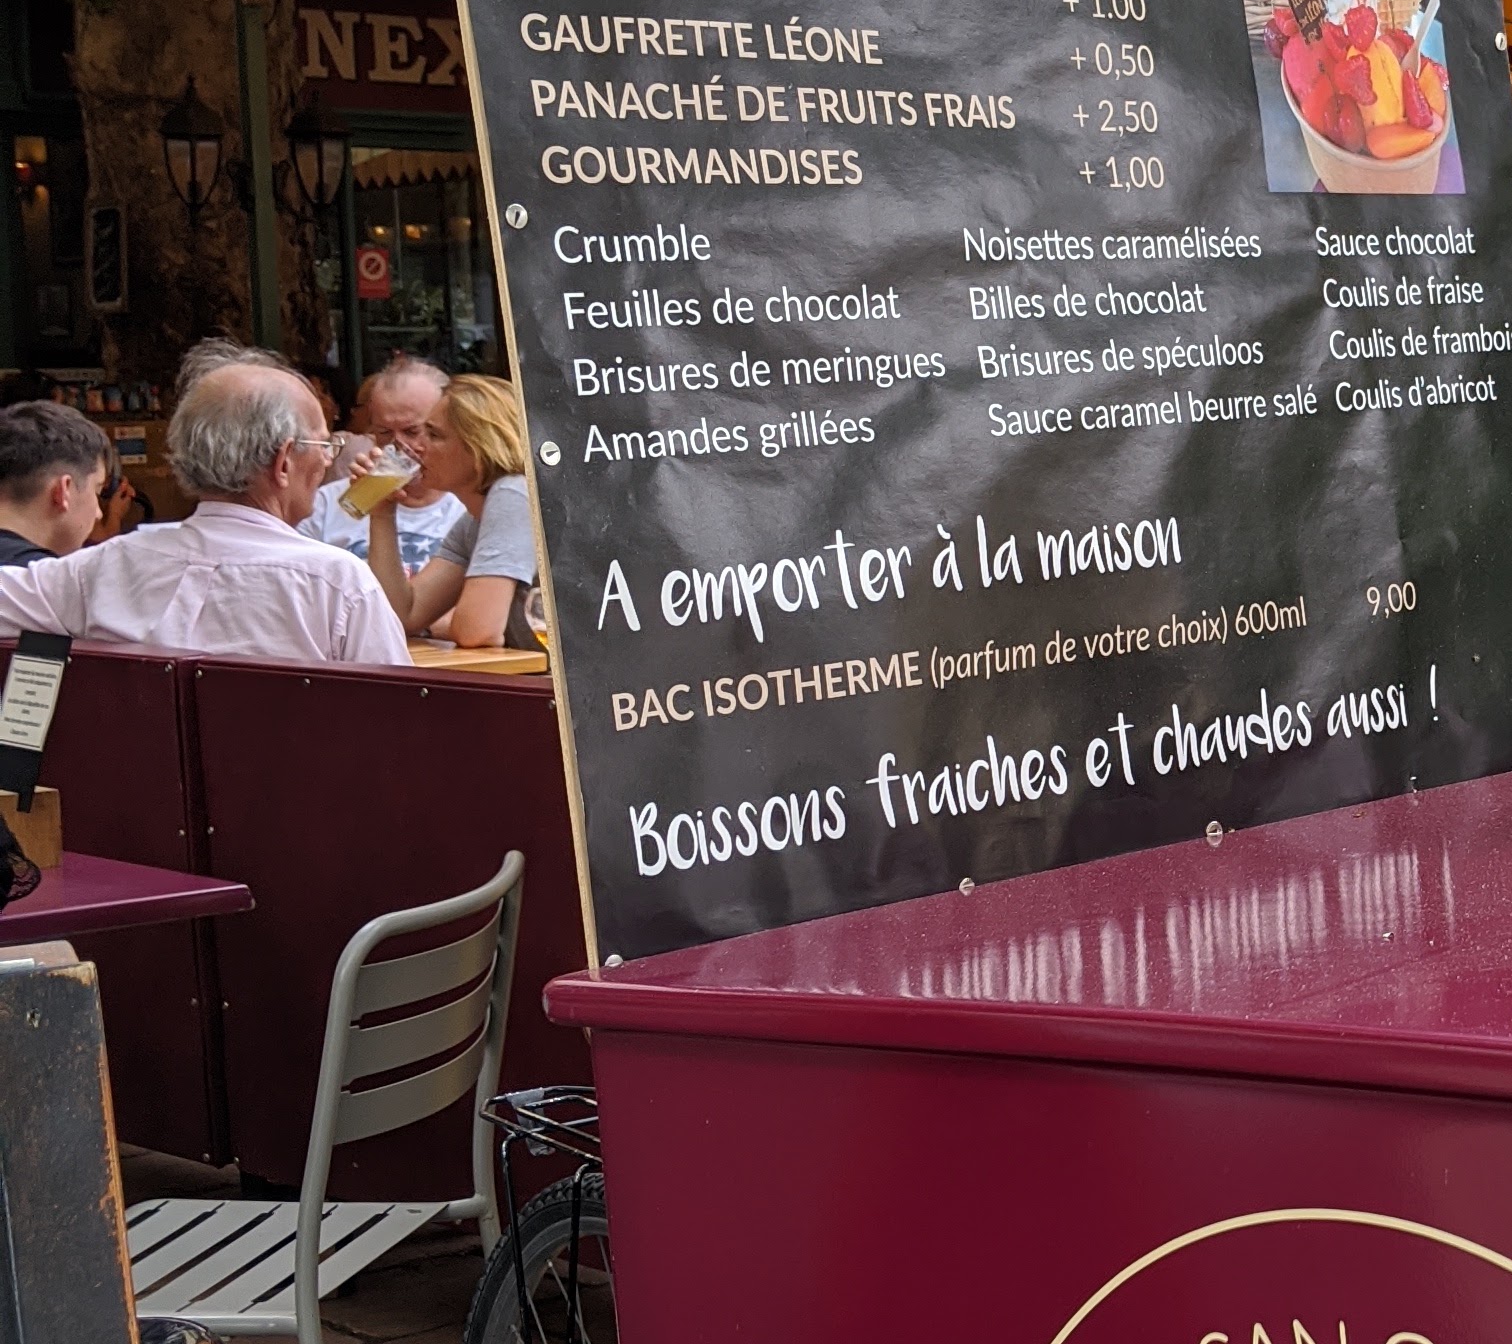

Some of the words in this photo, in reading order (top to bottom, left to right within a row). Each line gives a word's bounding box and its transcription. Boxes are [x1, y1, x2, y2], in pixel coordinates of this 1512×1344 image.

[520, 12, 759, 59] GAUFRETTE
[764, 15, 884, 65] LÉONE
[529, 74, 729, 122] PANACHÉ
[736, 82, 791, 122] DE
[796, 86, 918, 133] FRUITS
[923, 92, 1016, 130] FRAIS
[541, 142, 863, 185] GOURMANDISES
[553, 222, 712, 264] Crumble
[962, 225, 1095, 263] Noisettes
[1101, 225, 1262, 260] caramélisées
[1315, 224, 1381, 257] Sauce
[1385, 224, 1477, 256] chocolat
[562, 288, 702, 331] Feuilles
[712, 286, 755, 325] de
[764, 283, 902, 323] chocolat
[968, 281, 1046, 321] Billes
[1052, 283, 1088, 318] de
[1094, 280, 1208, 317] chocolat
[1322, 276, 1391, 309] Coulis
[1395, 274, 1423, 307] de
[1426, 273, 1485, 307] fraise
[976, 343, 1095, 379] Brisures
[1101, 338, 1136, 372] de
[1141, 333, 1265, 375] spéculoos
[1328, 327, 1397, 360] Coulis
[1401, 324, 1429, 357] de
[571, 355, 720, 398] Brisures
[729, 350, 772, 388] de
[781, 346, 946, 389] meringues
[1335, 378, 1404, 413] Coulis
[988, 402, 1073, 437] Sauce
[1080, 390, 1183, 431] caramel
[1187, 390, 1268, 423] beurre
[1272, 383, 1318, 417] salé
[583, 416, 749, 464] Amandes
[759, 408, 876, 458] grillées
[596, 558, 642, 632] A
[660, 528, 912, 644] emporter
[932, 523, 964, 592] à
[976, 514, 1024, 589] la
[1036, 516, 1182, 581] maison
[611, 683, 695, 732] BAC
[702, 650, 924, 718] ISOTHERME
[930, 639, 1036, 690] (parfum
[1044, 629, 1078, 665] de
[1082, 623, 1151, 659] votre
[1157, 605, 1228, 648] choix)
[1234, 595, 1308, 640] 600ml
[1366, 581, 1417, 620] 9,00
[628, 785, 847, 877] Boissons
[864, 734, 1069, 829] fraiches
[1085, 711, 1136, 788] et
[1152, 687, 1317, 776] chaudes
[1326, 682, 1409, 739] aussi
[1429, 662, 1440, 722] !
